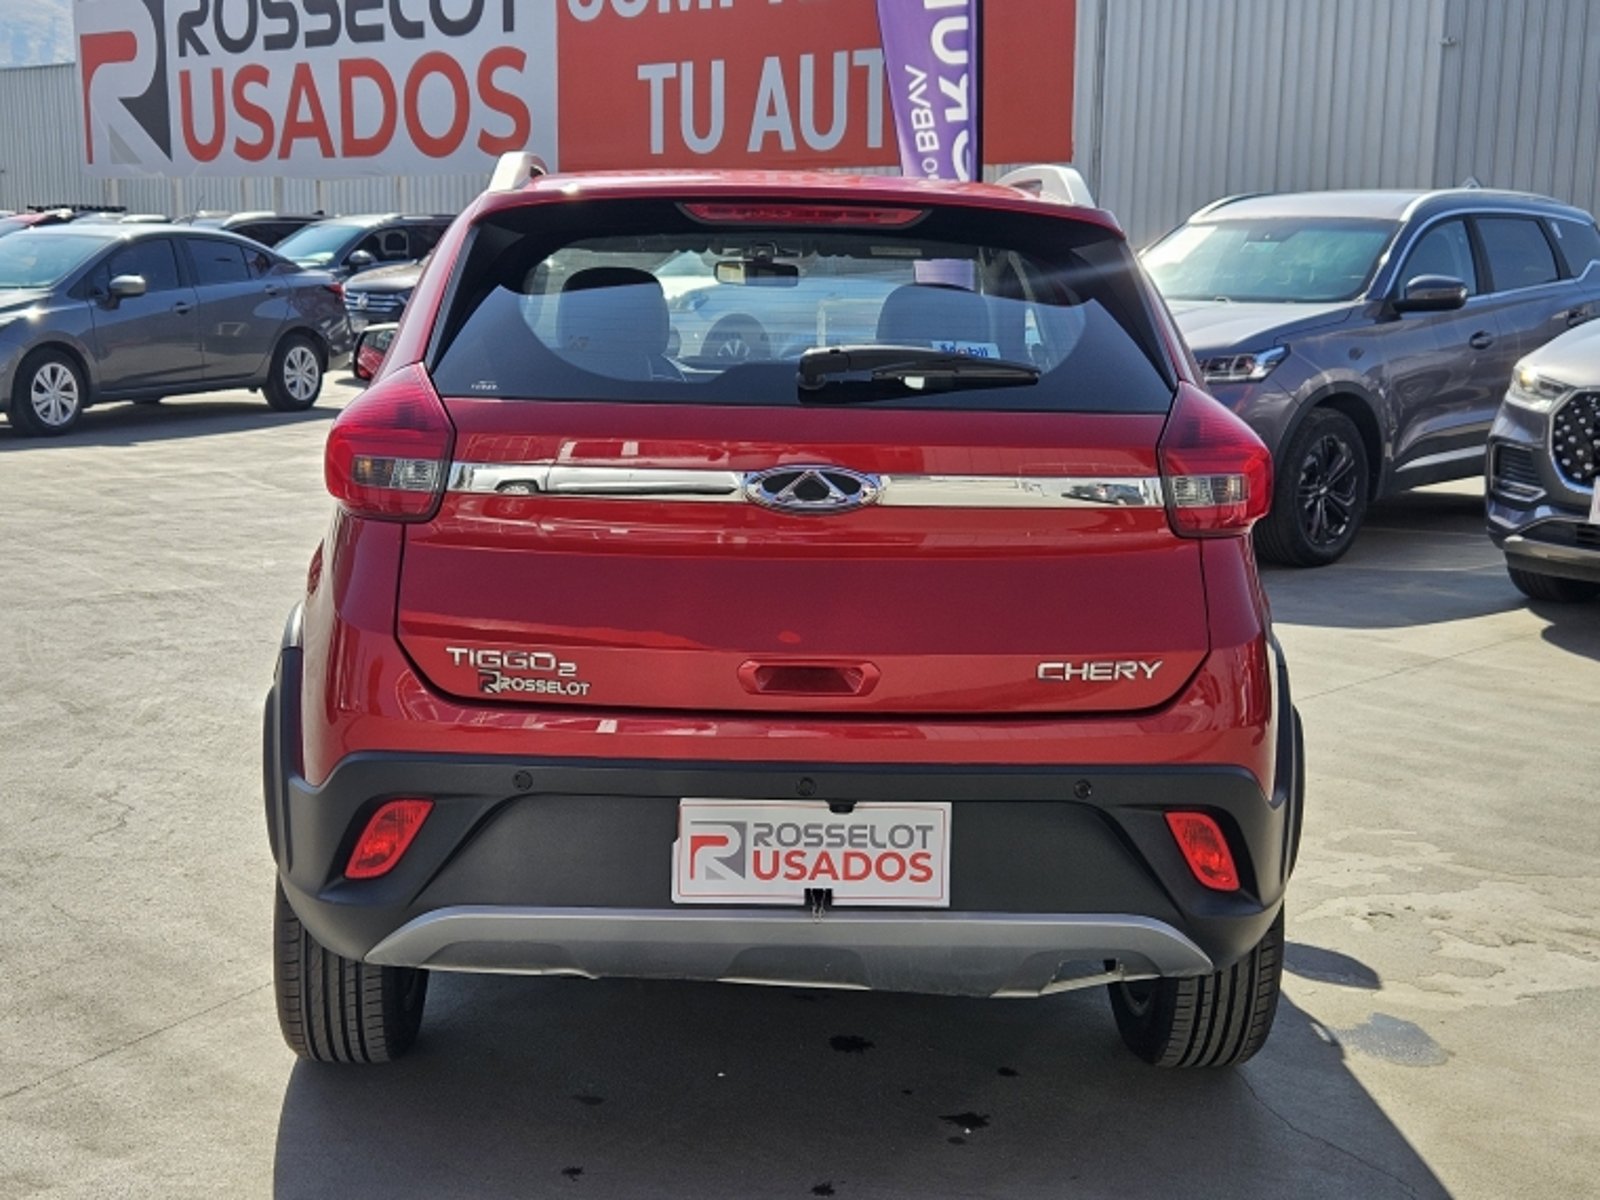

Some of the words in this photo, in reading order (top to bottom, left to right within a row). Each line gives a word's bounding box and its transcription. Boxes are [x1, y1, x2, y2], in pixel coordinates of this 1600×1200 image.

[178, 45, 532, 163] USADOS
[637, 59, 725, 154] TU
[1037, 660, 1163, 681] CHERY
[500, 677, 590, 696] ROSSELOT
[752, 822, 934, 849] ROSSELOT
[752, 850, 934, 883] USADOS
